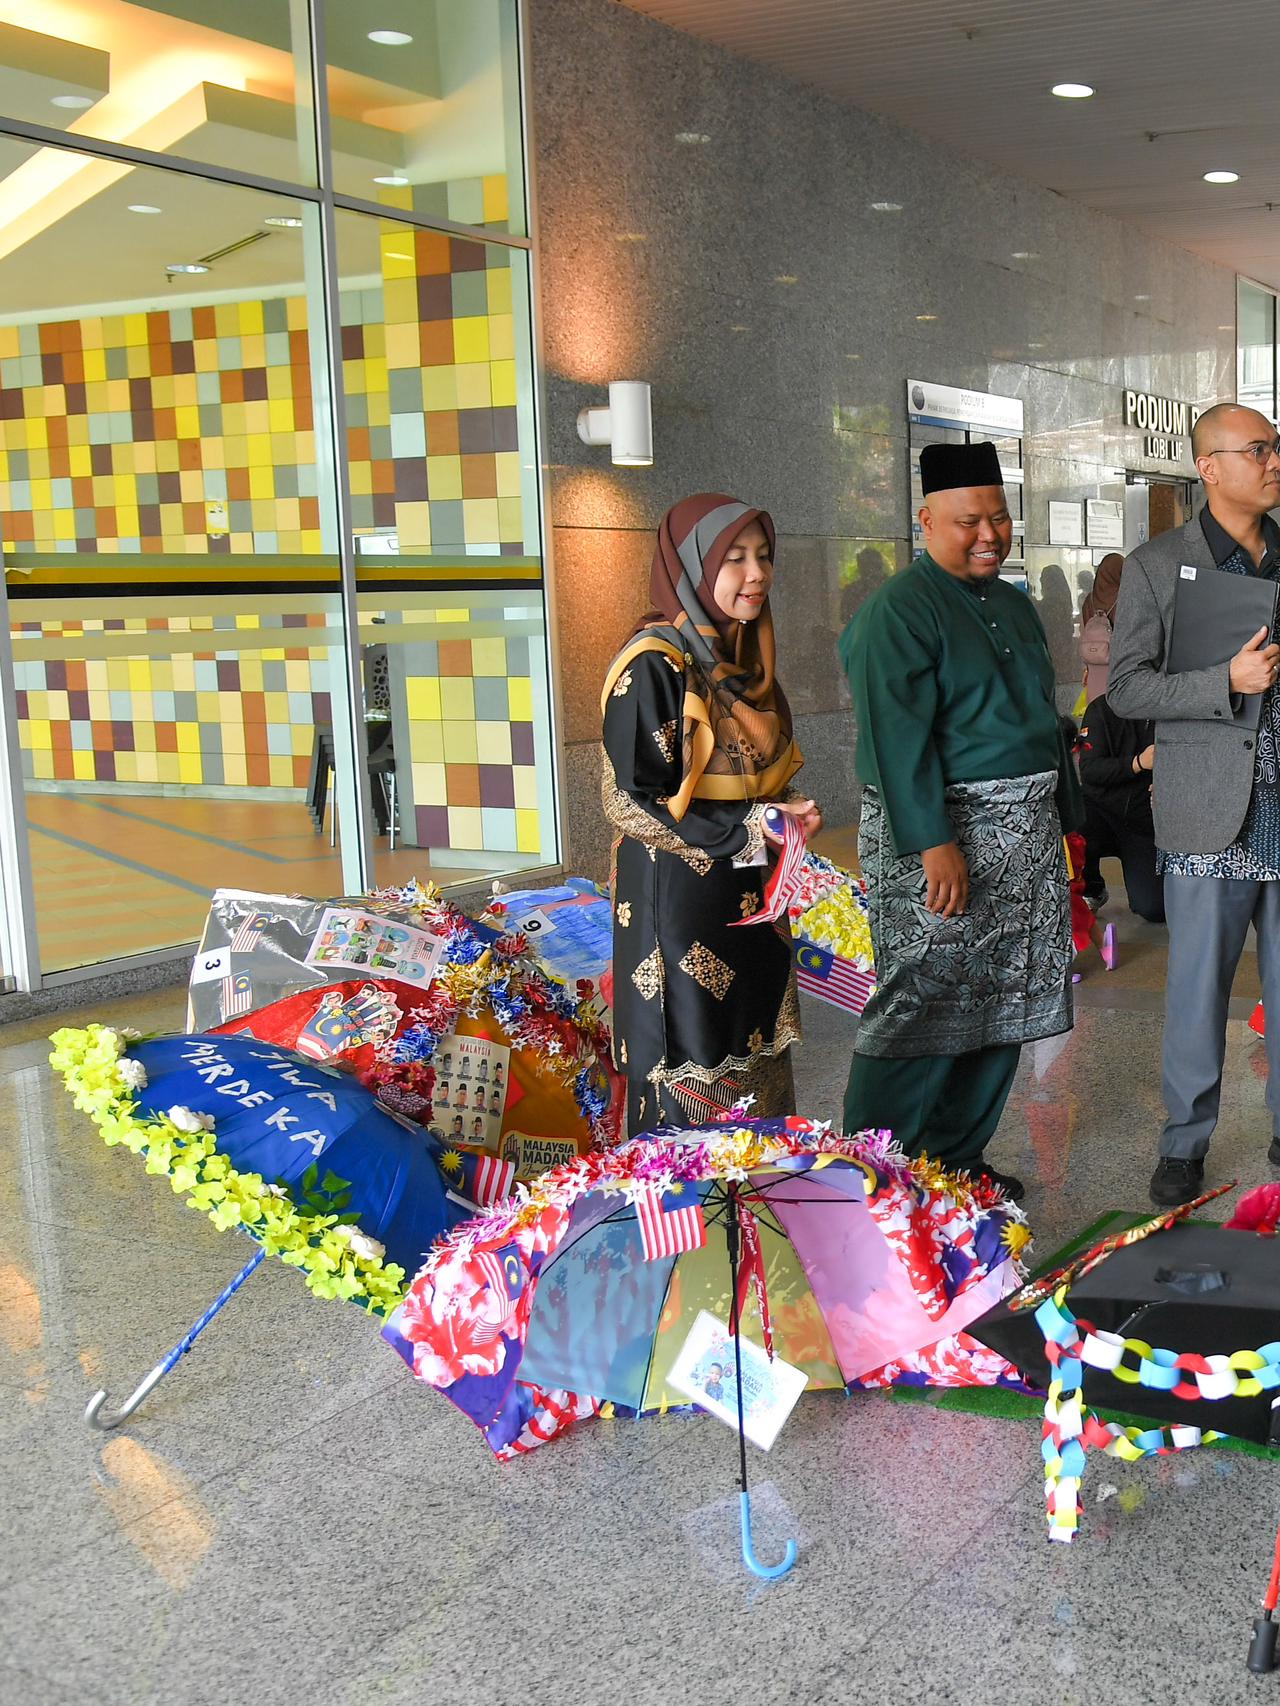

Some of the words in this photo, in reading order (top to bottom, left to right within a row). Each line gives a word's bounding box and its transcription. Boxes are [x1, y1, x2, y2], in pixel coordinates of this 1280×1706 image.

[1126, 391, 1186, 435] PODIUM
[1147, 436, 1168, 460] LOBI
[205, 958, 221, 970] 3
[459, 1043, 492, 1057] MALAYSIA
[248, 1052, 337, 1112] JIWA
[523, 1139, 575, 1154] MALAYSIA
